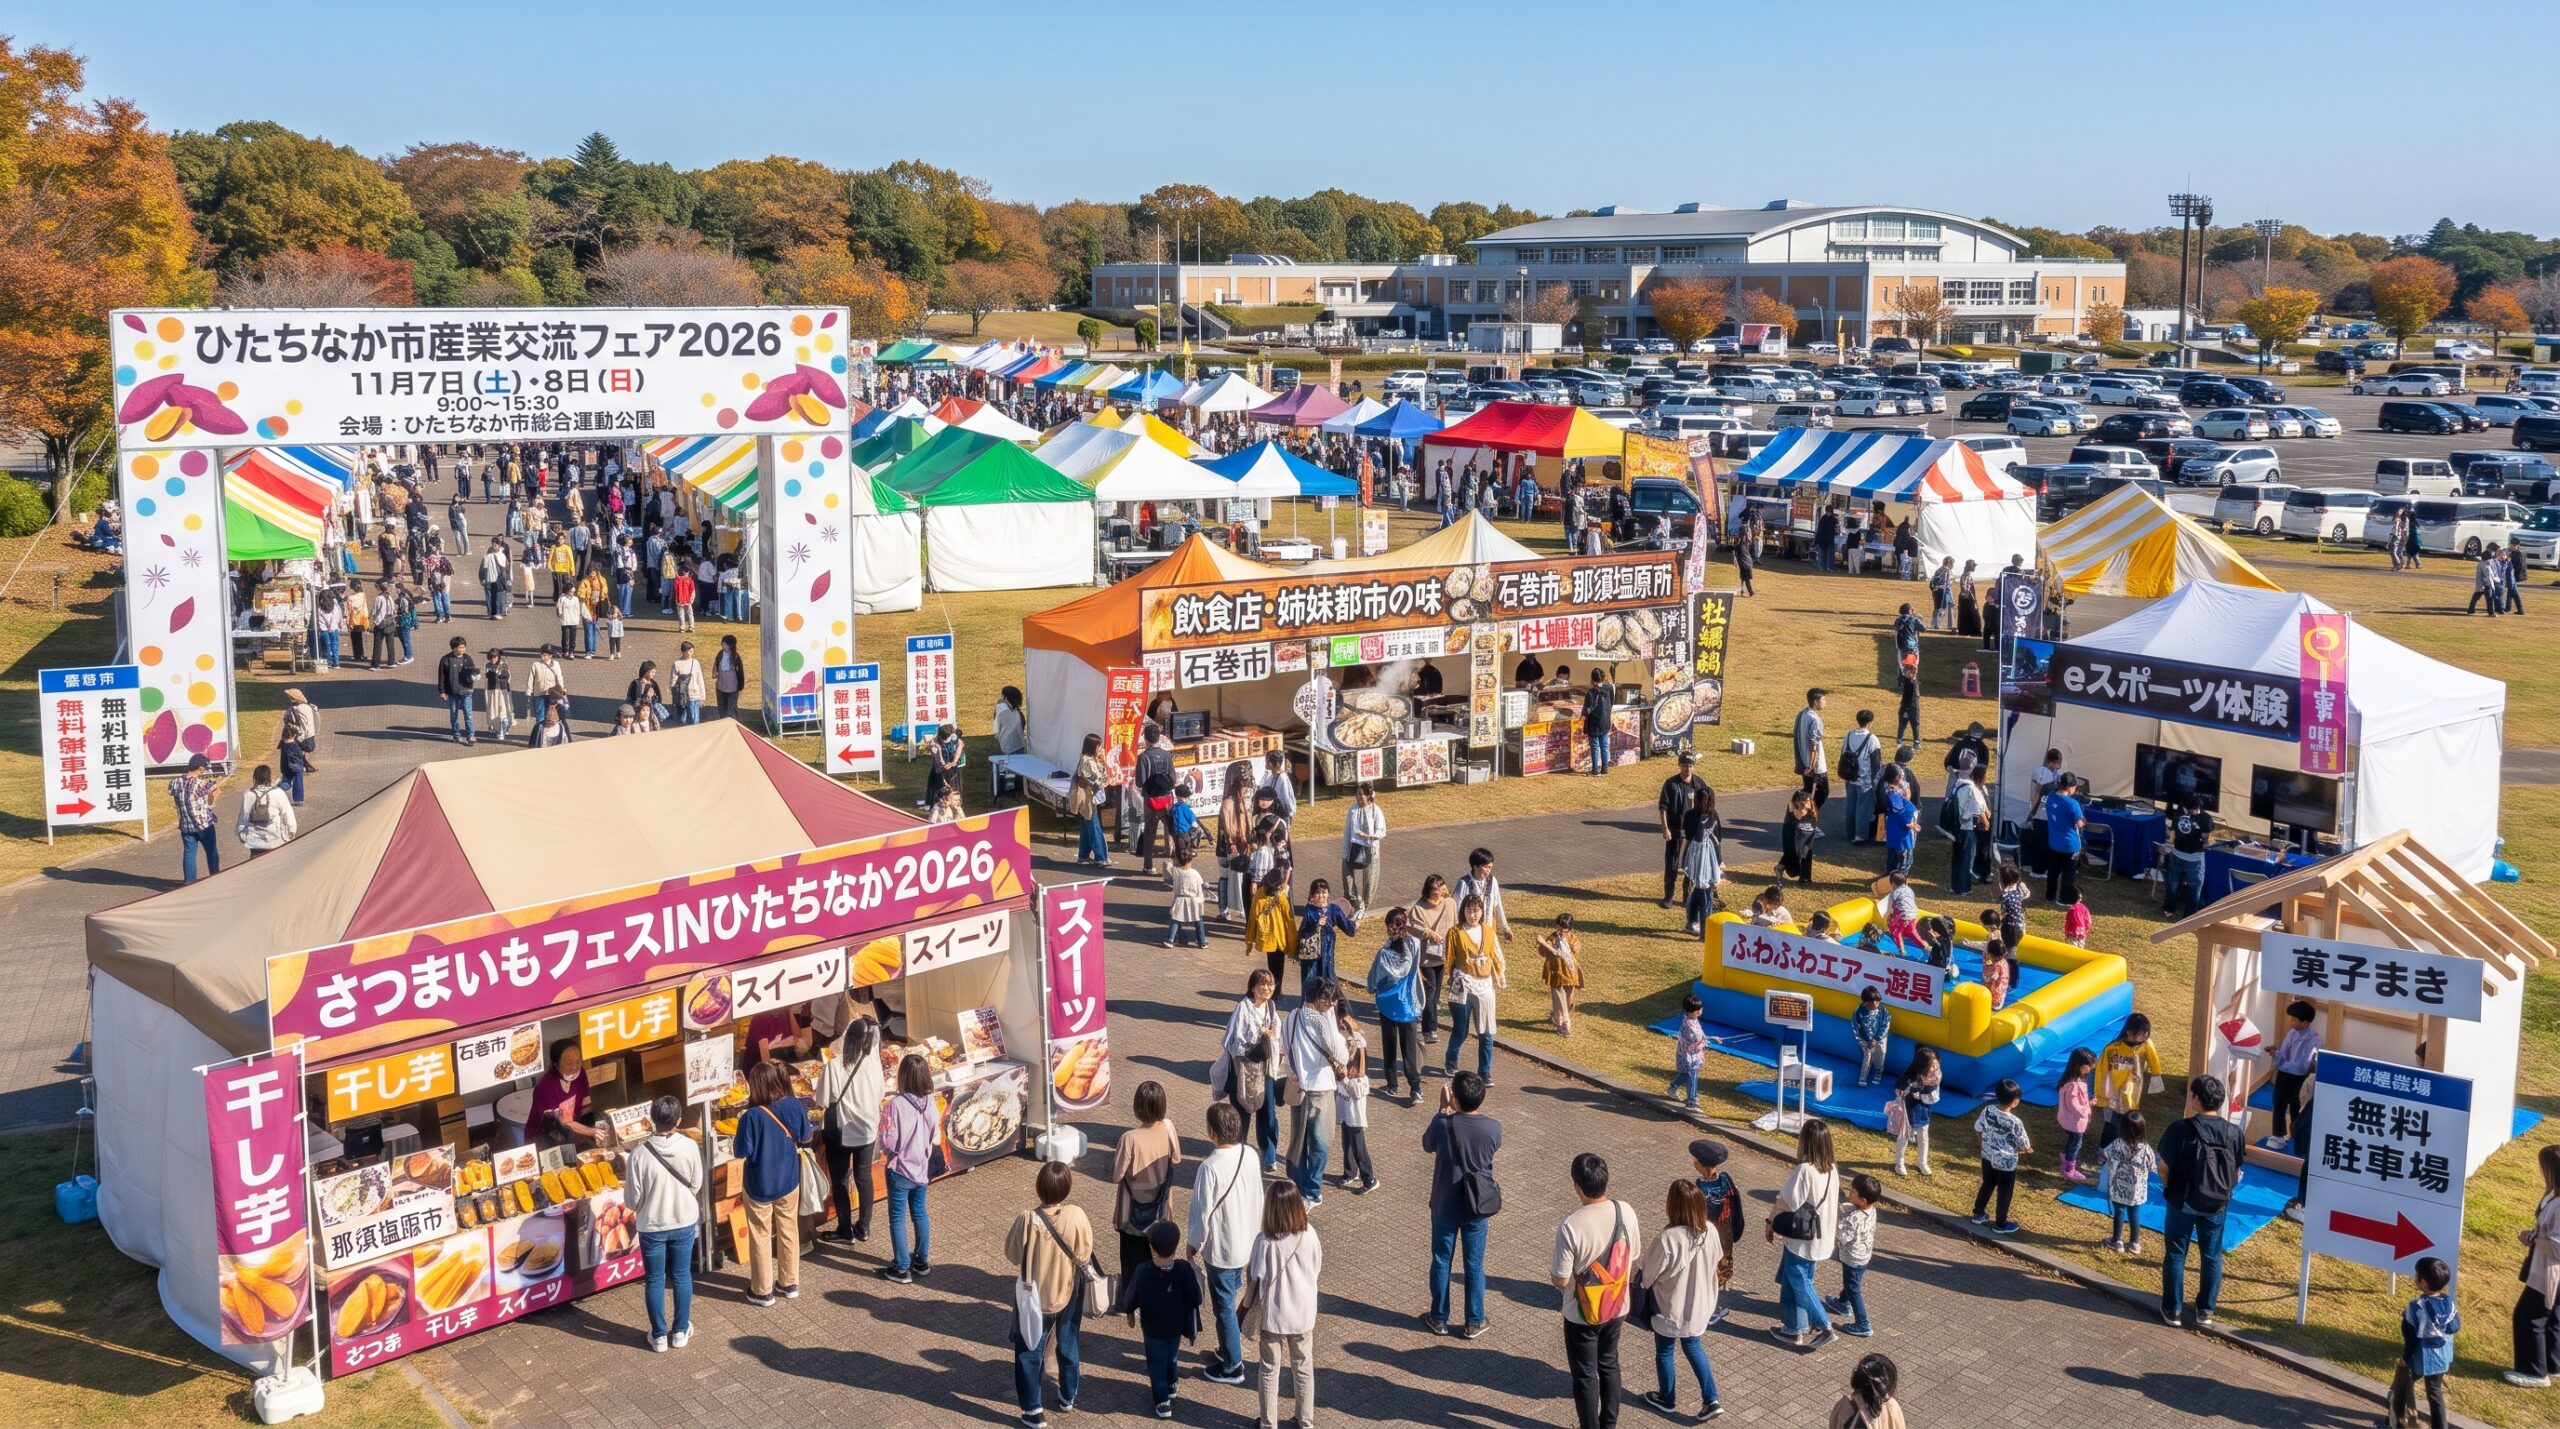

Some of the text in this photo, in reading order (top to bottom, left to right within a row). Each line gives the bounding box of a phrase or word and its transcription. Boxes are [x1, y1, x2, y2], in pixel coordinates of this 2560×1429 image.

[194, 321, 782, 364] ひたちなか市産業交流フェア2026
[1173, 578, 1442, 635] 飲食店・姉妹都市の味
[1498, 570, 1560, 608] 石巻市
[1184, 646, 1268, 684] 石巻市
[2063, 662, 2289, 728] eスポーツ体験
[101, 697, 133, 813] 無料駐車場
[316, 840, 995, 1029] さつまいもフェスINひたちなか2026
[911, 918, 1004, 965] スイーツ
[737, 957, 840, 1009] スイーツ
[1057, 898, 1096, 1034] スイーツ
[1731, 932, 1933, 1006] ふわふわエアー遊具
[2292, 947, 2449, 1005] 菓子まき
[584, 995, 673, 1050] 干し芋
[334, 1051, 447, 1112] 干し芋
[2348, 1096, 2432, 1147] 無料
[226, 1070, 292, 1247] 干し芋
[2322, 1133, 2450, 1194] 駐車場
[425, 1306, 478, 1339] 干し芋
[497, 1280, 563, 1319] スイーツ
